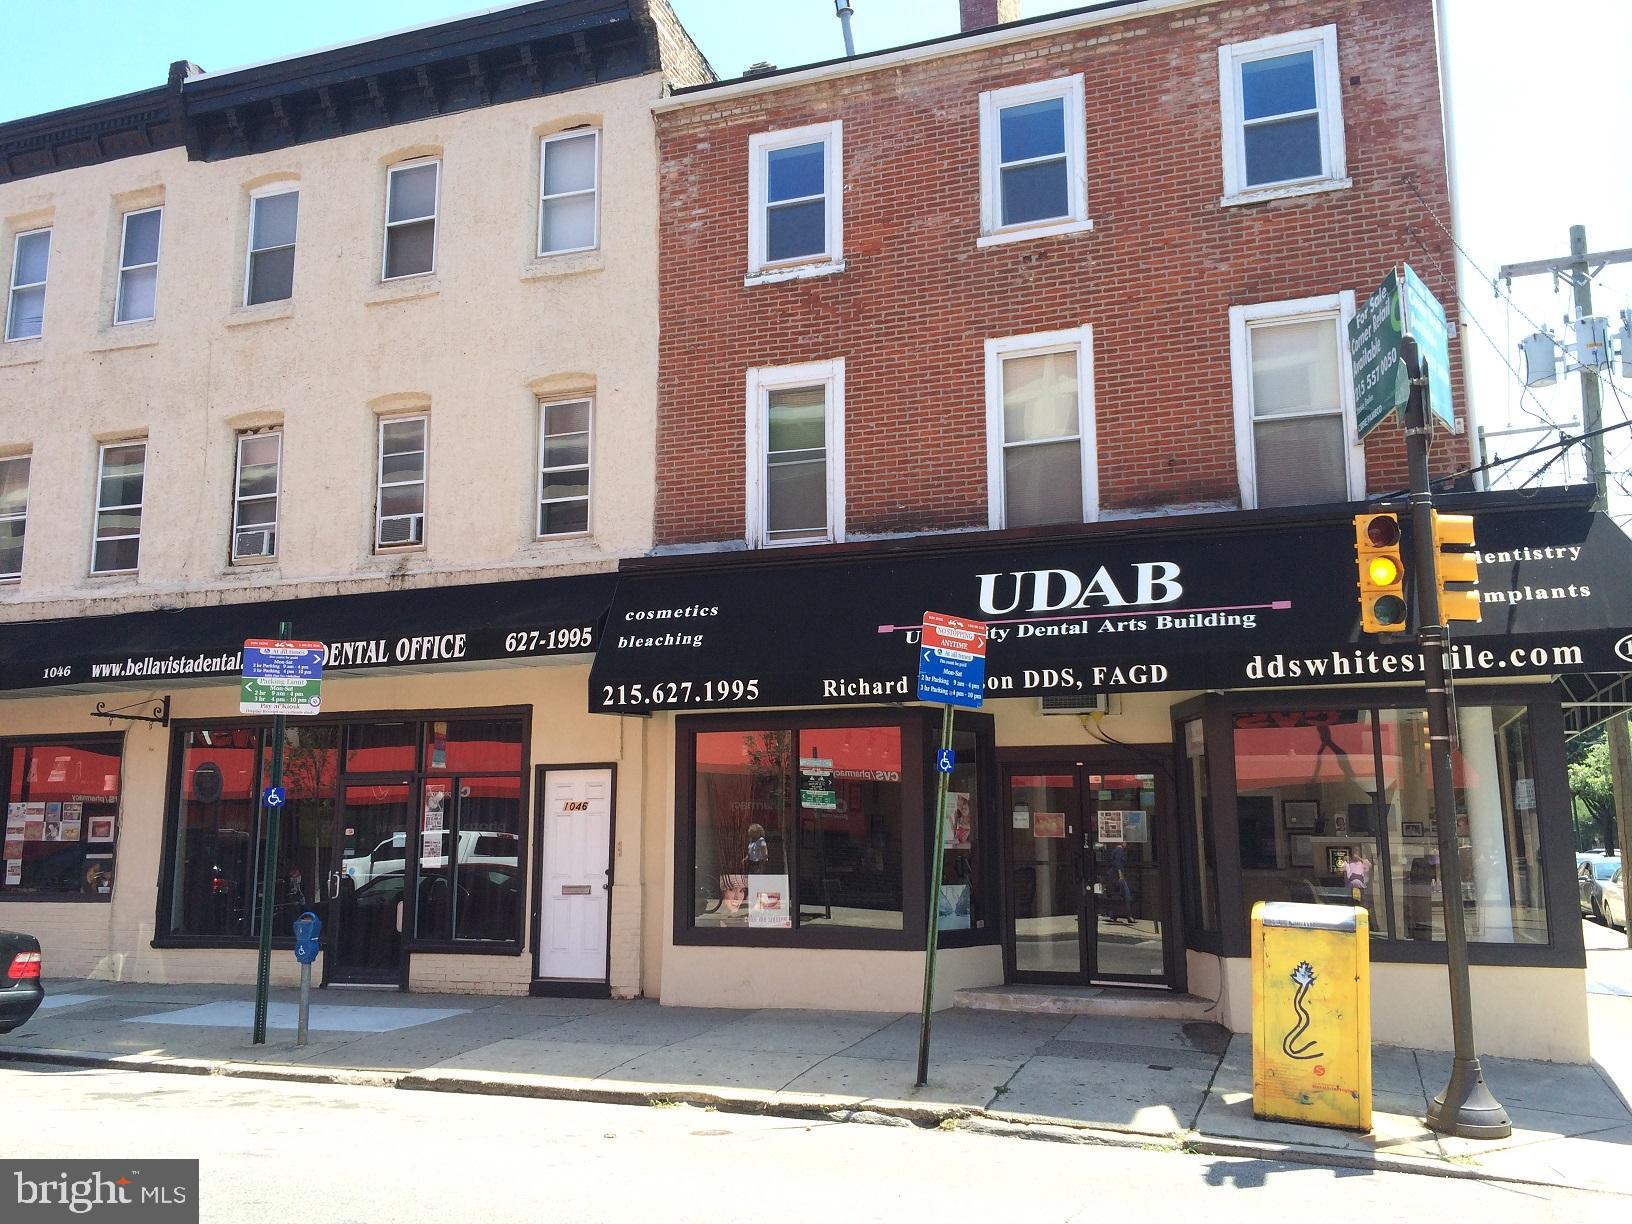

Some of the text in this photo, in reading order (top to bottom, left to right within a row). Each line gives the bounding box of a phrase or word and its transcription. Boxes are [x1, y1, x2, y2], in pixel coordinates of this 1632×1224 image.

[1356, 286, 1387, 329] For Sale
[1352, 297, 1390, 356] Corner Retail
[1353, 337, 1381, 379] Available
[1366, 366, 1380, 391] 557
[1381, 346, 1397, 376] 0050
[976, 561, 1184, 615] UDAB
[625, 604, 719, 621] cosmetics
[946, 628, 973, 640] STOPPING
[1016, 619, 1094, 639] Dental
[1098, 615, 1148, 633] Arts
[1155, 612, 1257, 630] Building
[395, 633, 467, 660] OFFICE
[505, 627, 593, 651] 627-1995
[617, 632, 704, 649] bleaching
[940, 639, 968, 650] ANYTIME
[42, 665, 72, 679] 1046
[259, 678, 283, 686] Parking
[931, 676, 949, 686] Parking
[943, 668, 962, 677] Mon-Sat
[1022, 668, 1083, 692] DDS,
[1091, 664, 1168, 687] FAGD
[602, 679, 761, 706] 215.627.1995
[822, 675, 909, 698] Richard
[930, 686, 948, 695] Parking
[564, 801, 589, 812] 1046
